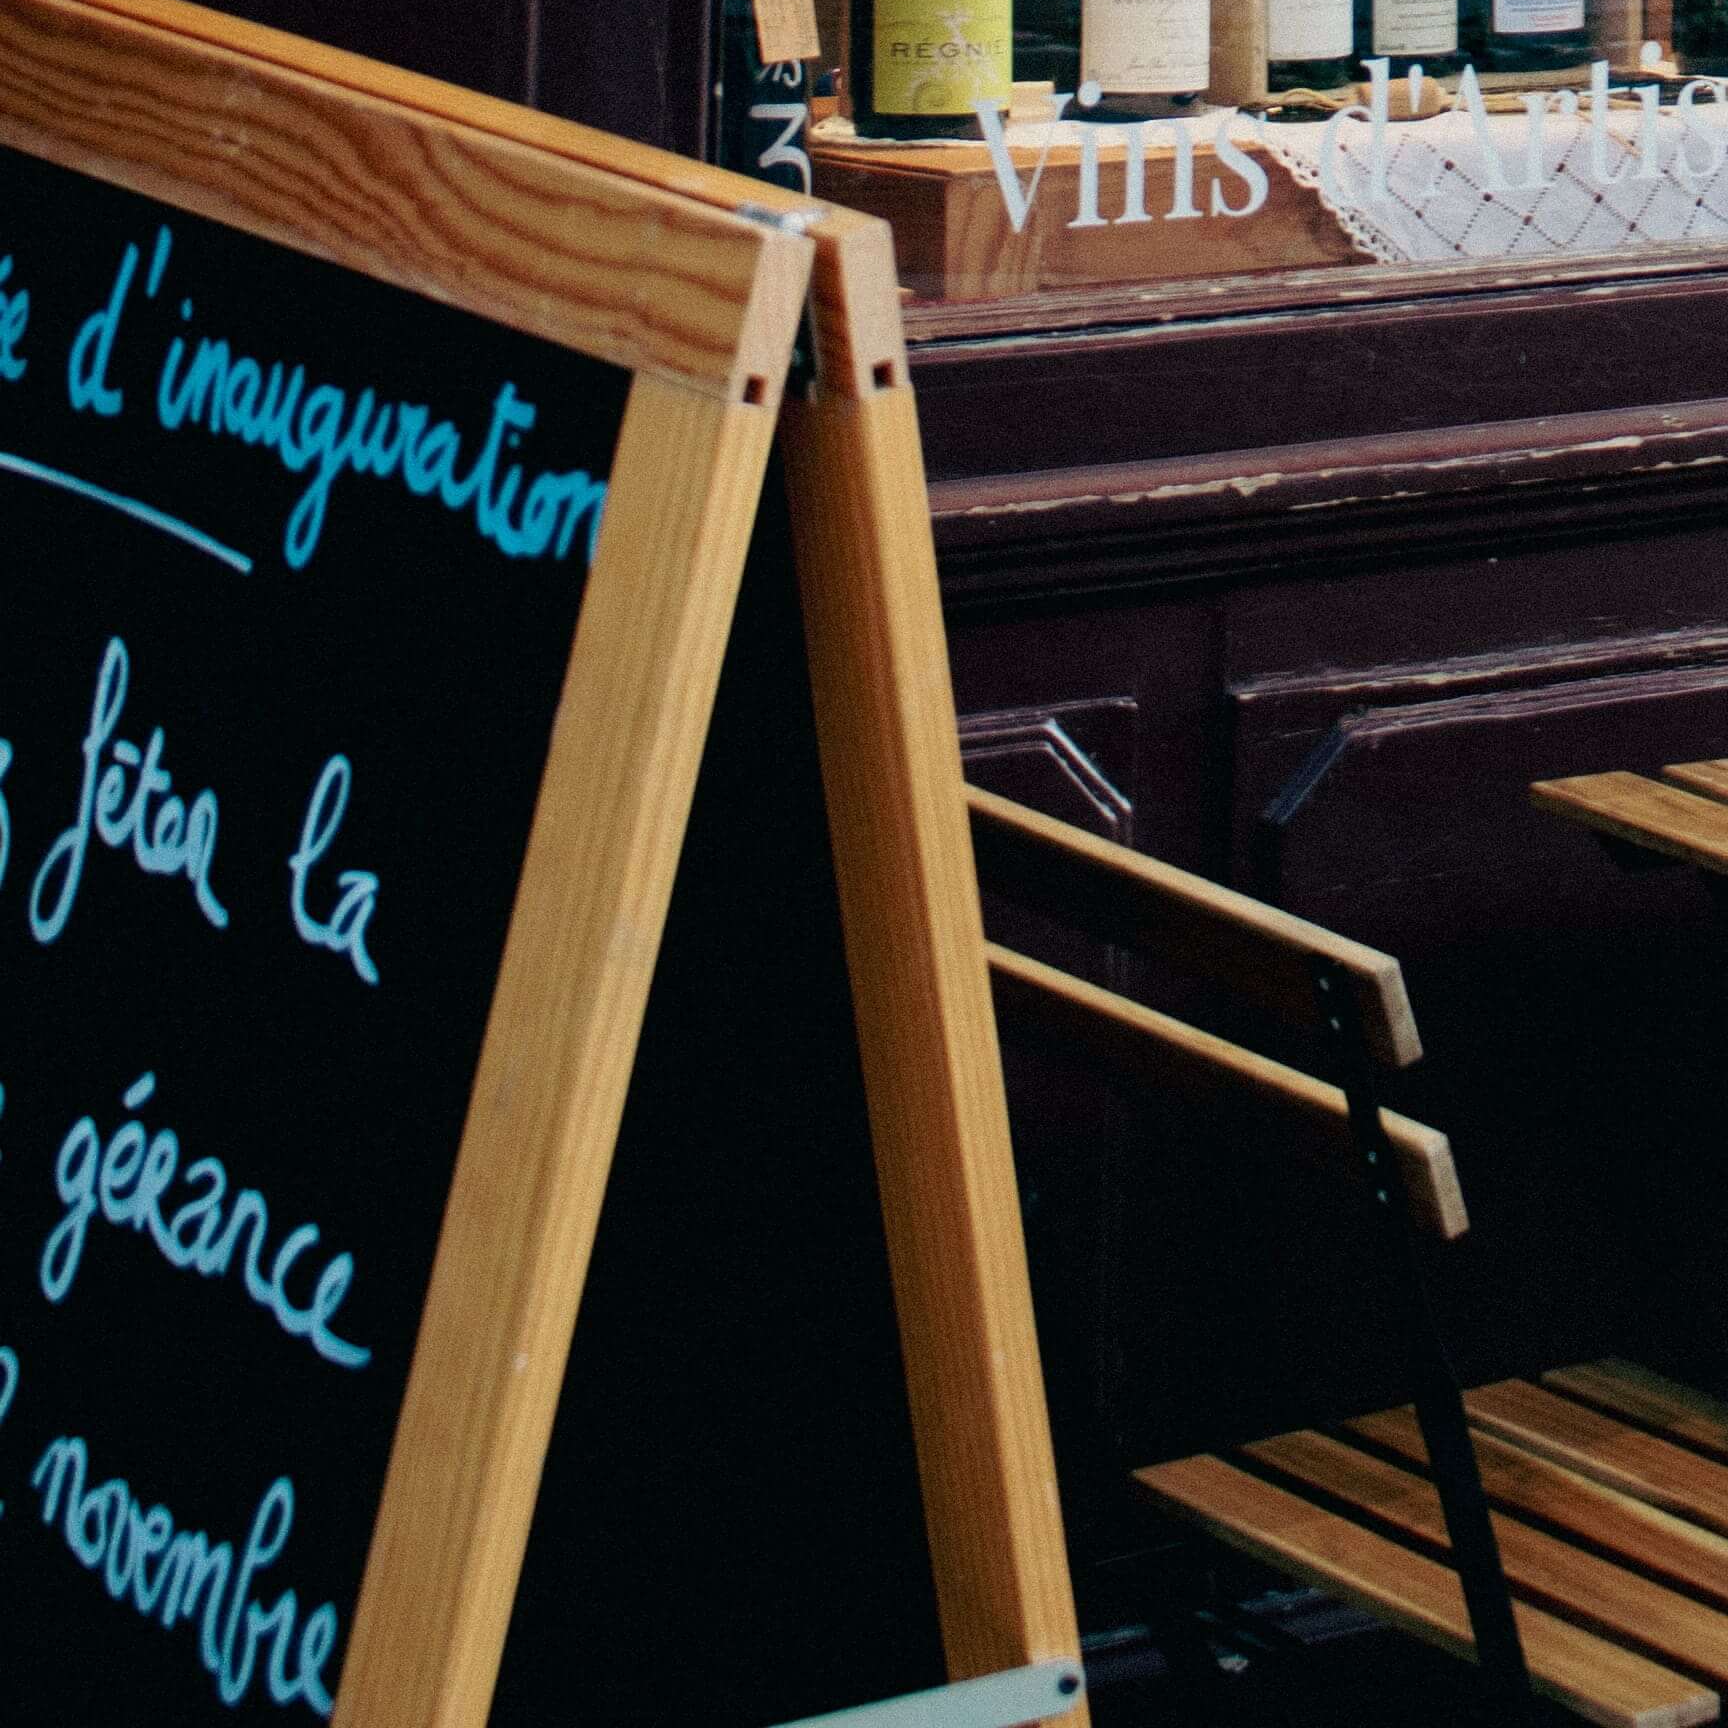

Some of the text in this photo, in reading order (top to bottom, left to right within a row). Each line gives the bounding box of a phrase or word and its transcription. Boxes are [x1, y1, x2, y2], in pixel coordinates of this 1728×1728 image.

[969, 80, 1270, 235] Vins
[67, 224, 608, 569] d'inauguration
[29, 635, 229, 944] fêter
[290, 754, 379, 985] la
[40, 1071, 372, 1371] gérance
[30, 1434, 336, 1718] novembre
